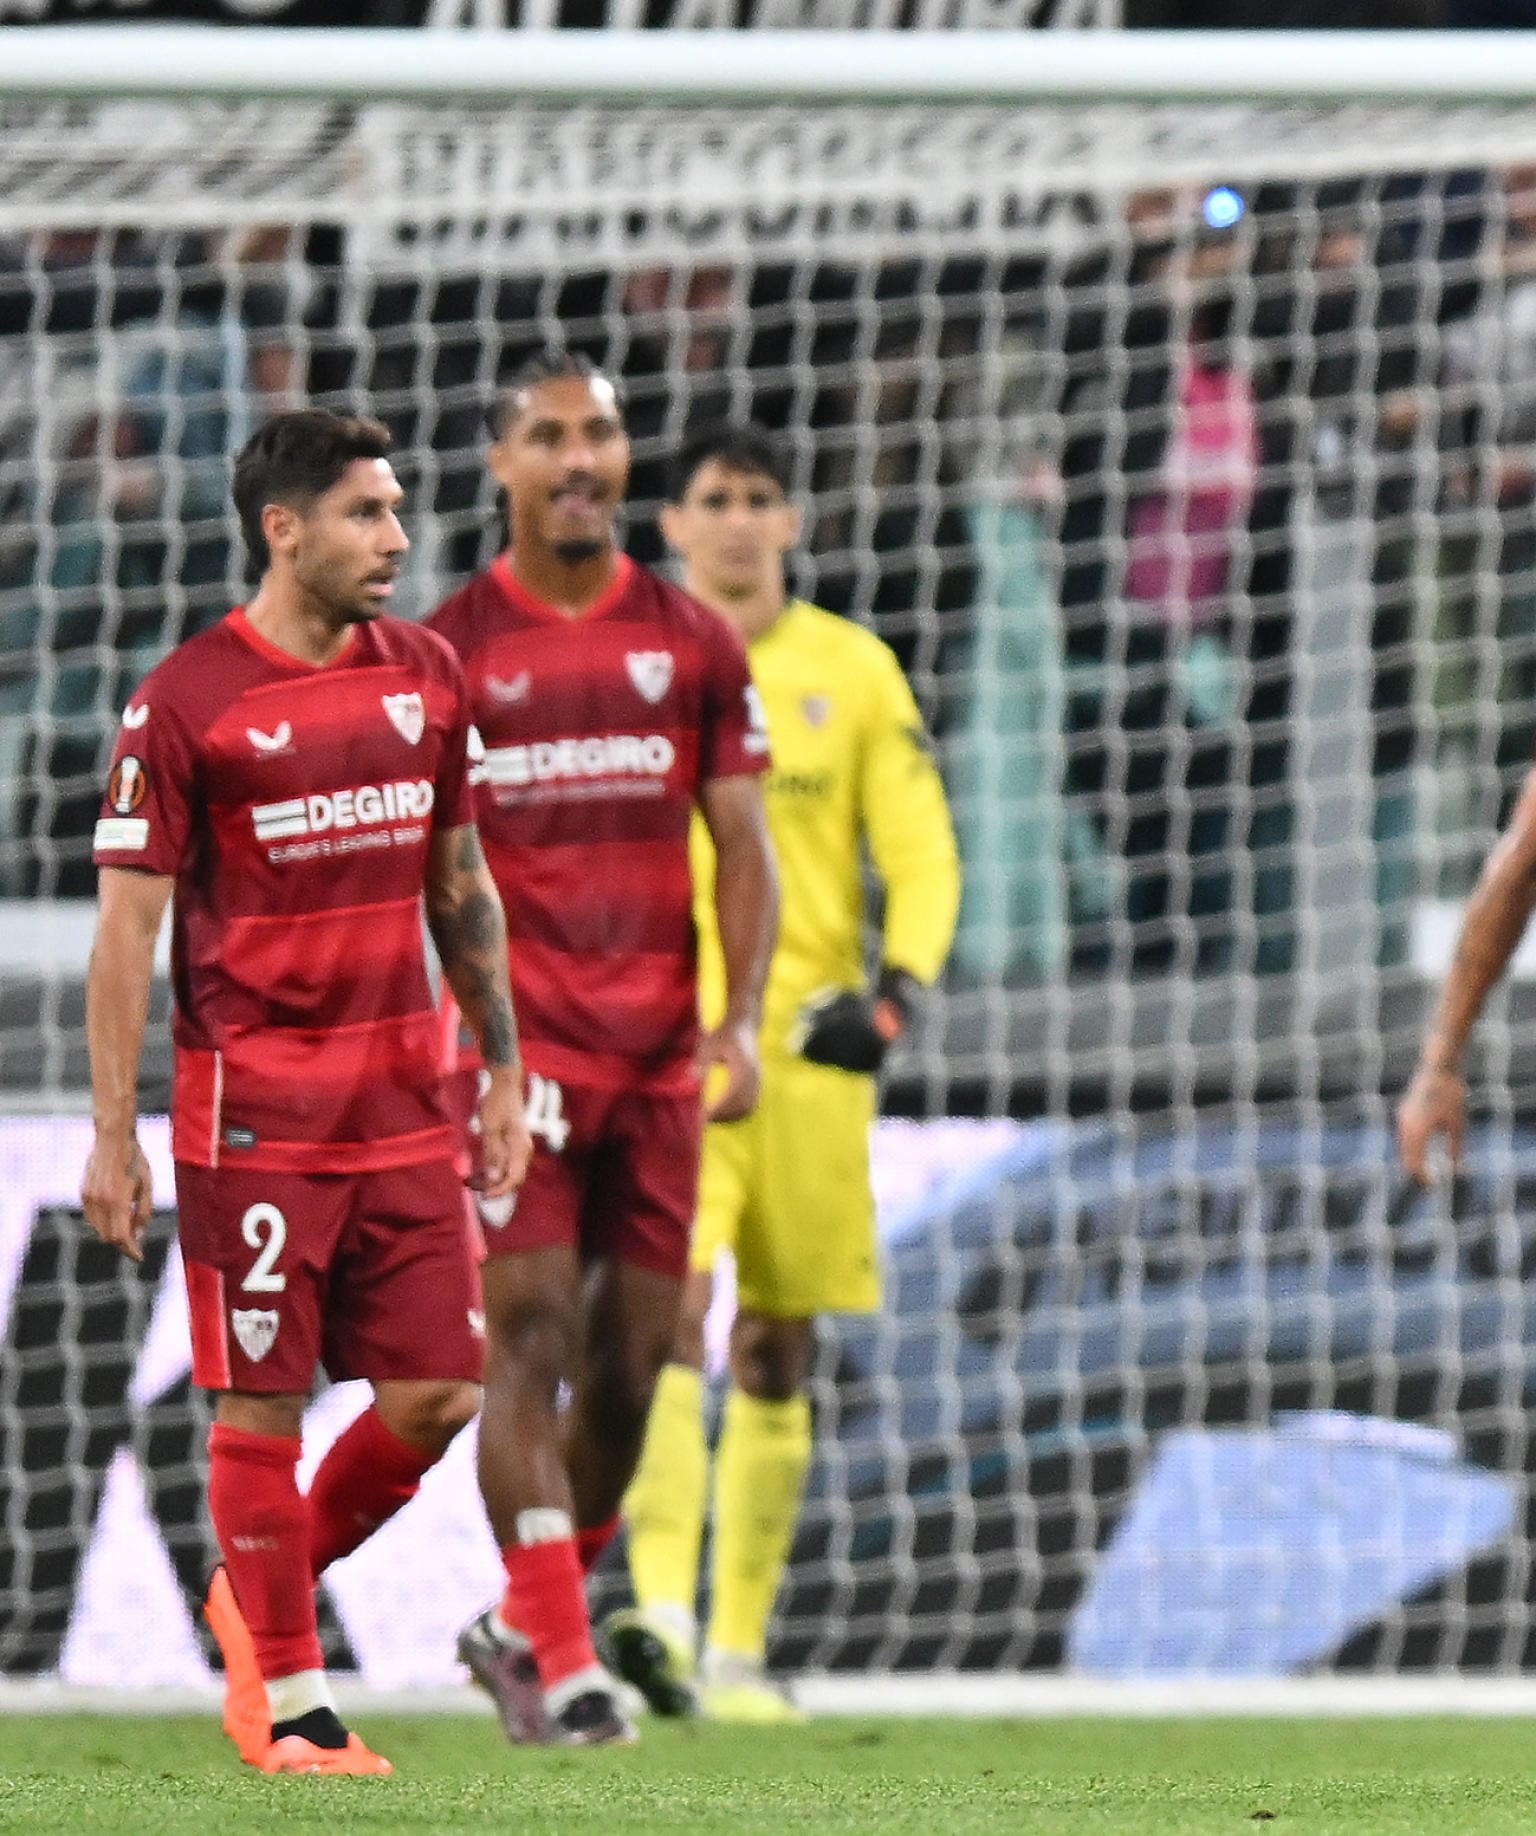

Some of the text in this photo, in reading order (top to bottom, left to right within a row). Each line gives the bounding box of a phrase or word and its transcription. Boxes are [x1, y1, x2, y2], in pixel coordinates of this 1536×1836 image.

[531, 735, 676, 780] DEGIRO
[307, 779, 435, 832] DEGIRO
[240, 1202, 288, 1292] 2
